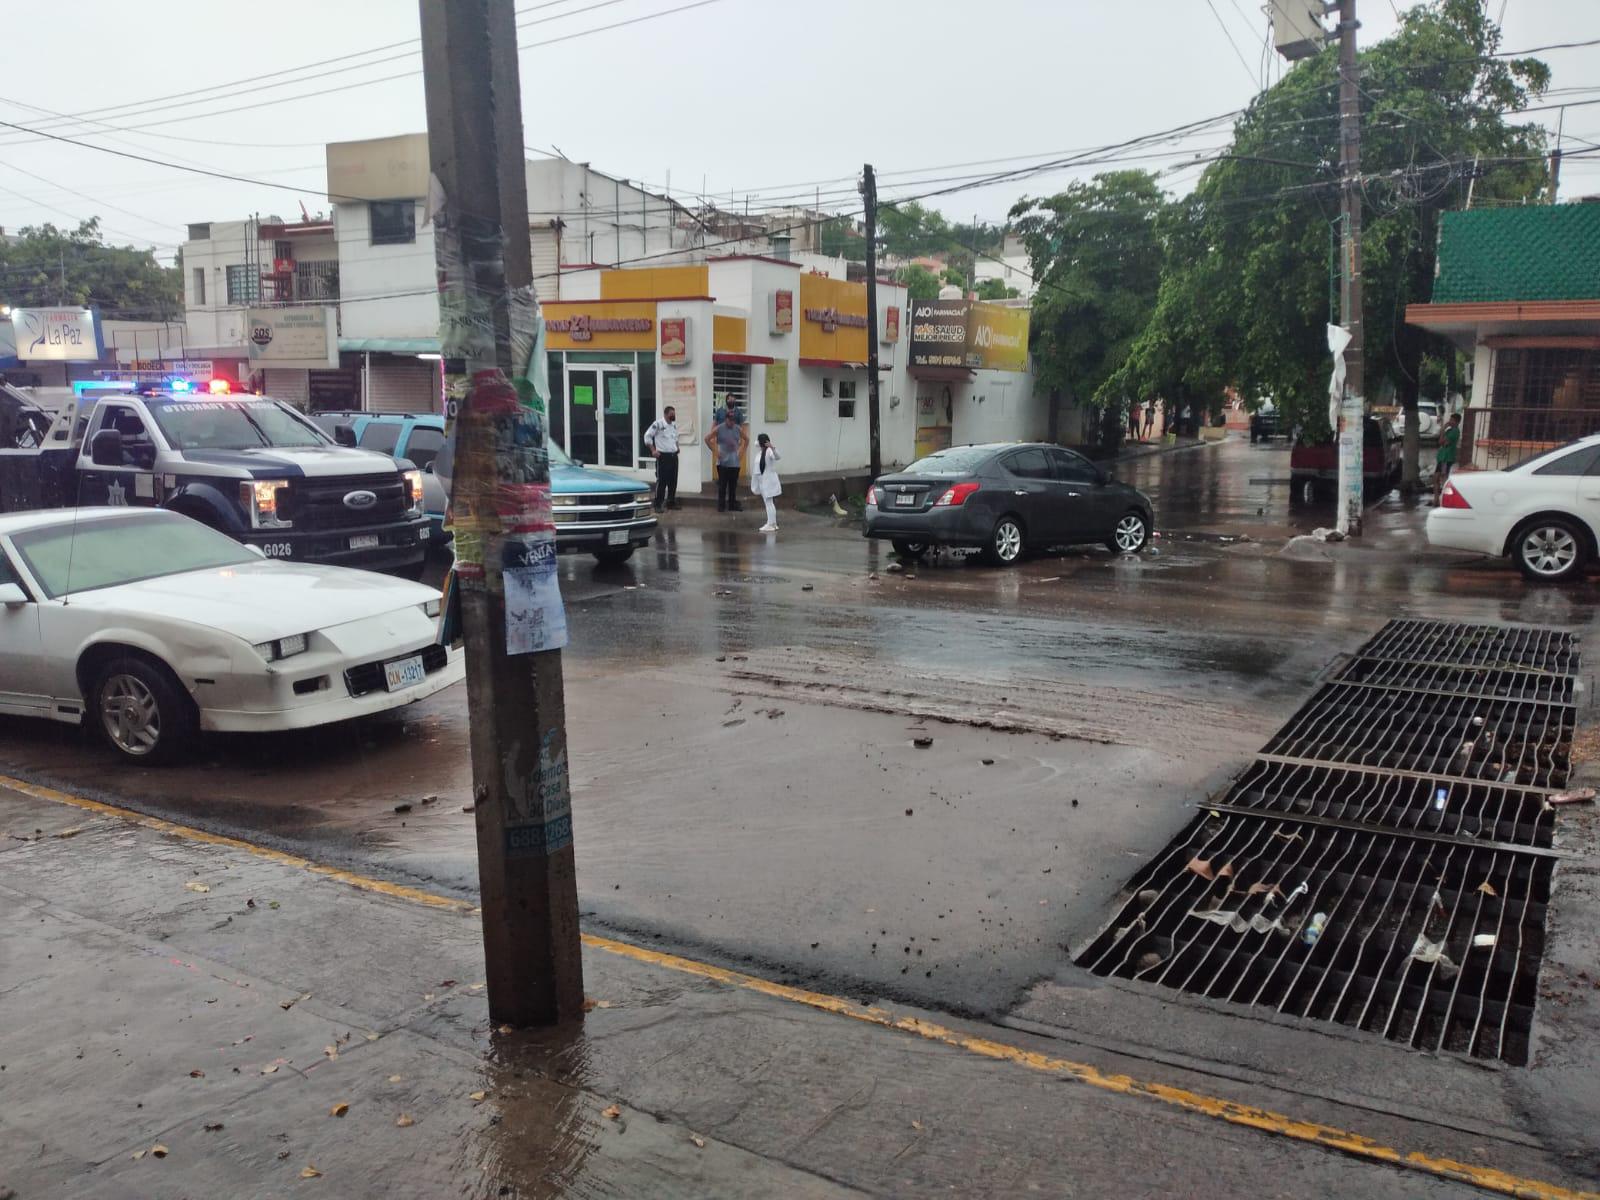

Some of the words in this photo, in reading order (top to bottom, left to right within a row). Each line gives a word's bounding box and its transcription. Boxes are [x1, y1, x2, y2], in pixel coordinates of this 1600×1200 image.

[48, 324, 61, 345] La
[62, 324, 82, 345] Paz
[254, 328, 270, 337] SOS
[914, 334, 938, 342] MEJOR
[264, 544, 291, 556] G026
